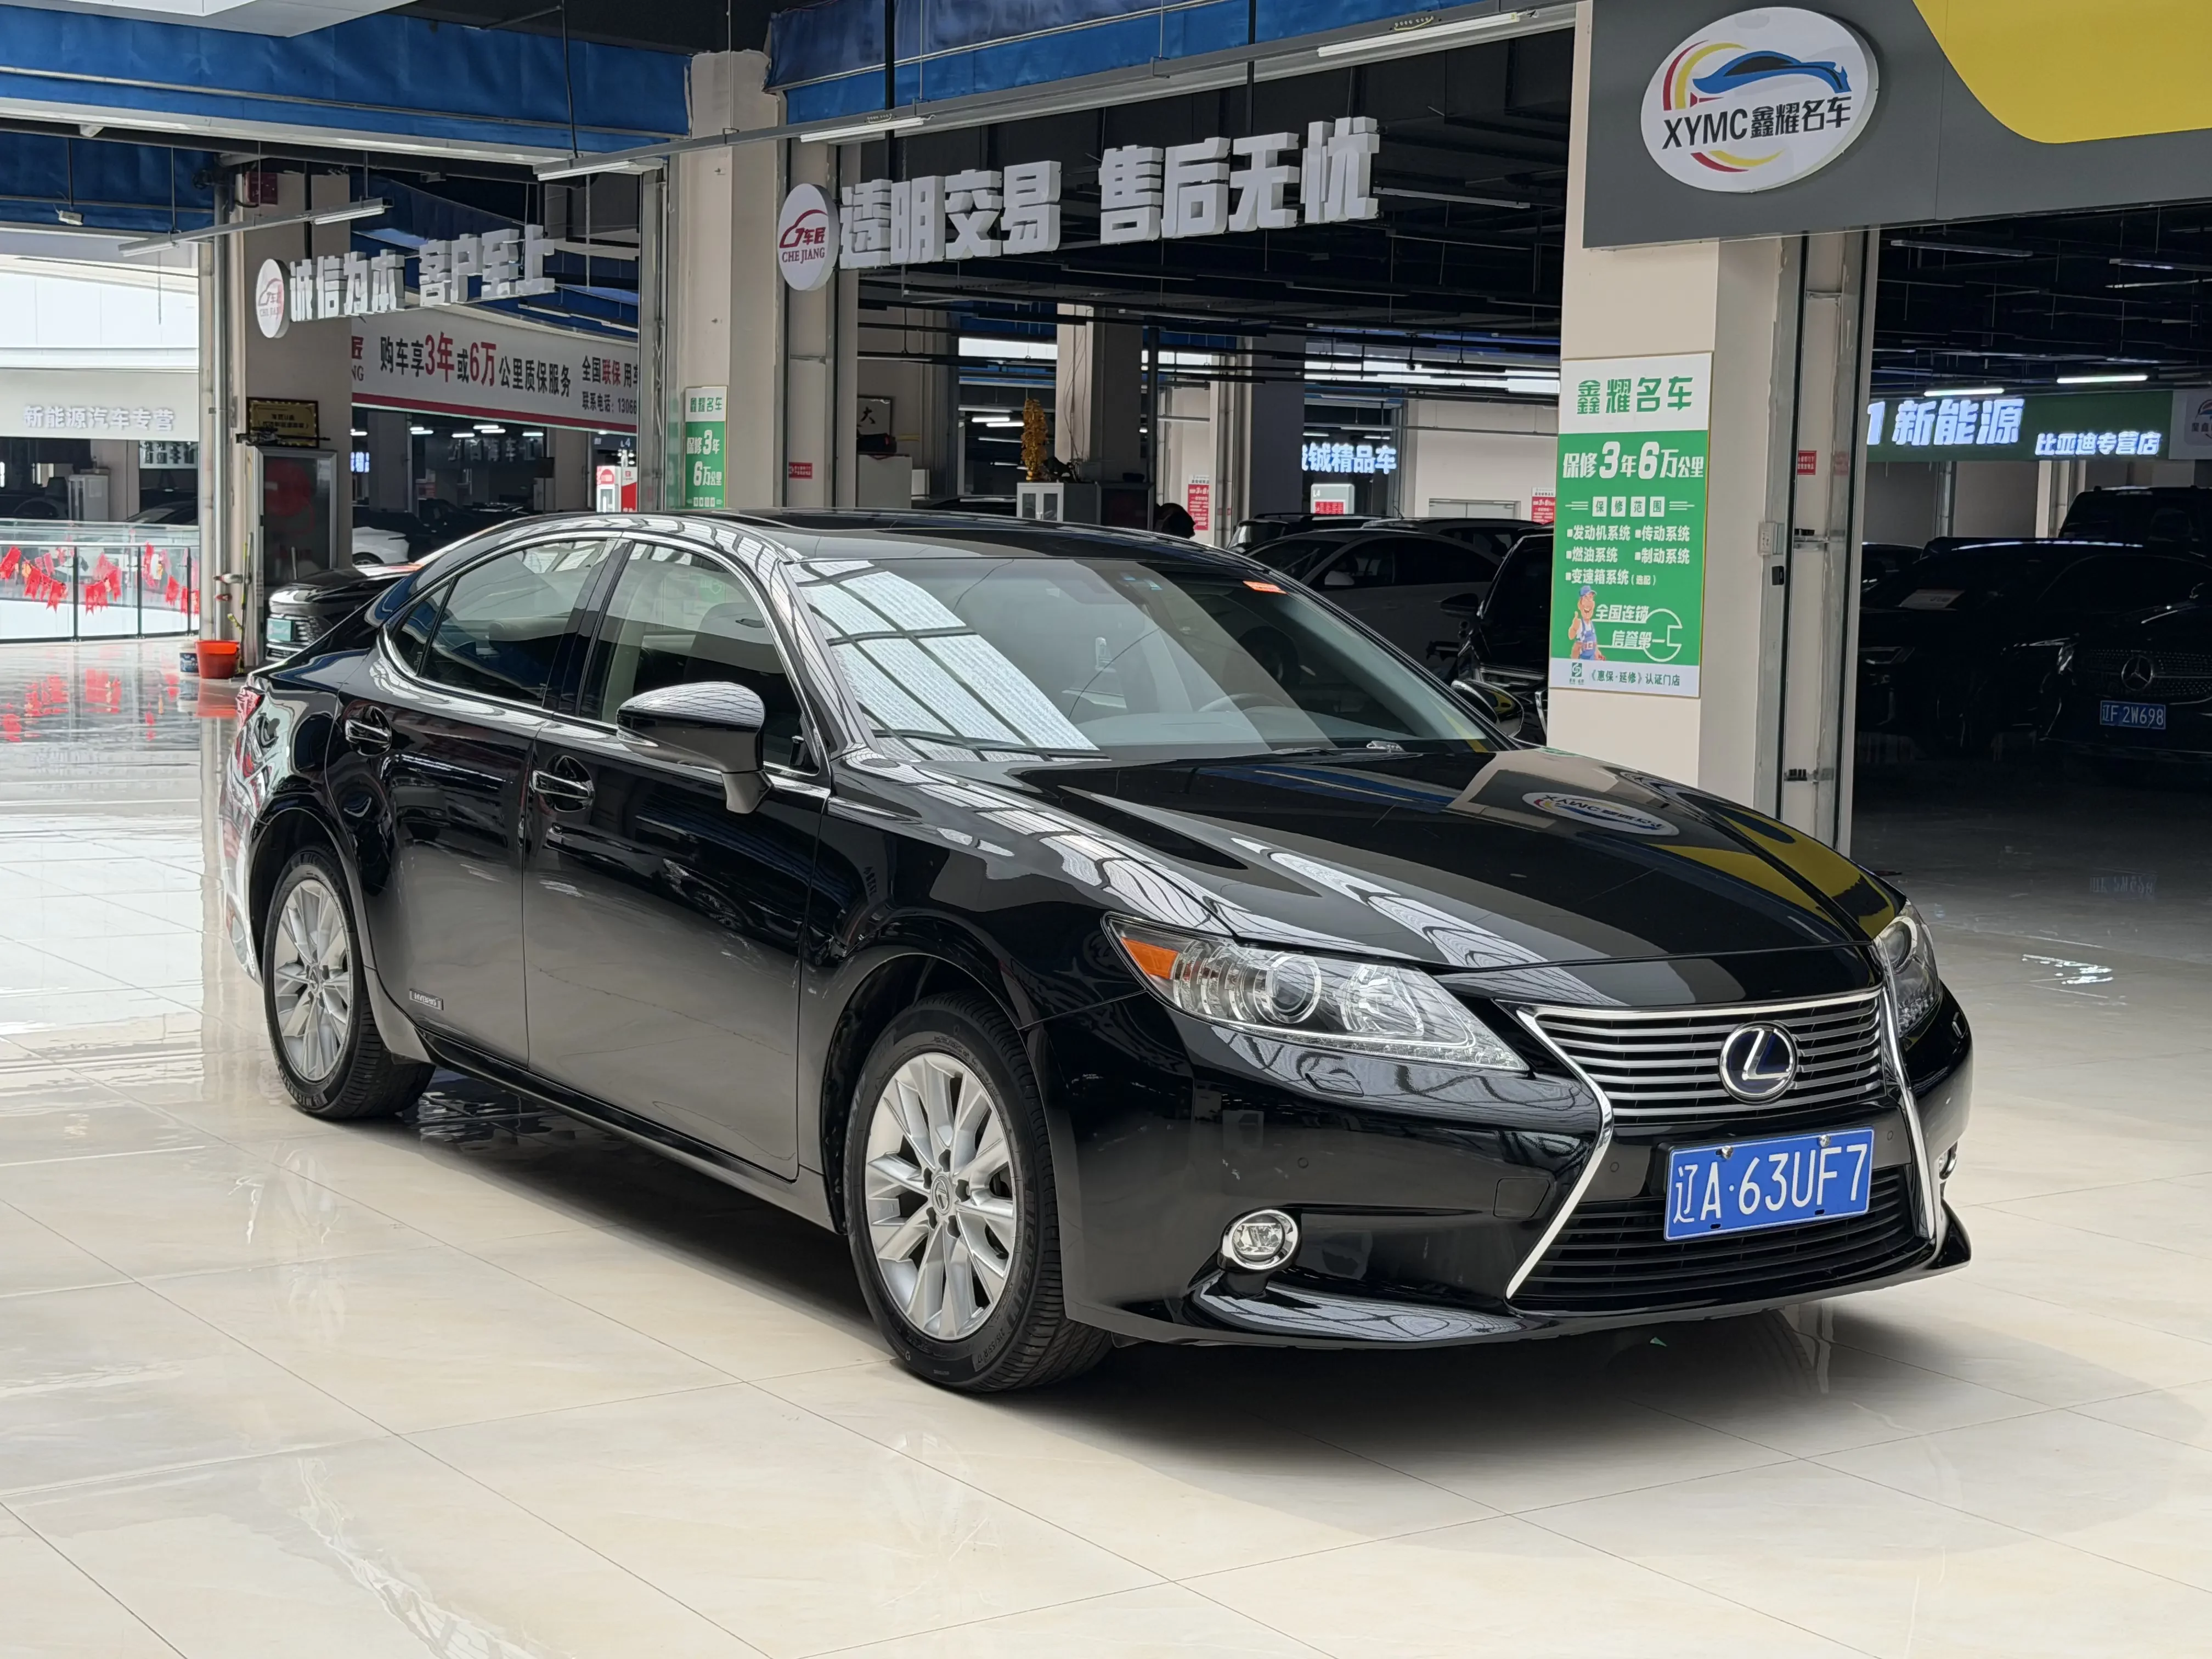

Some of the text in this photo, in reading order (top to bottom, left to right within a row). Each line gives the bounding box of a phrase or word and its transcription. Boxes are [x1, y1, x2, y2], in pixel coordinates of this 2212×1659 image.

[839, 116, 1380, 269] 透明交易 售后无忧
[782, 247, 825, 264] CHE JIANG
[290, 224, 555, 322] 诚信为本 客户至上
[380, 331, 571, 397] 购车享3年或6万公里质保服务
[582, 356, 621, 386] 全国联保
[1577, 376, 1693, 415] 鑫耀名车
[24, 405, 174, 432] 新能源汽车专营
[1892, 399, 2025, 445] 新能源
[687, 429, 720, 455] 保修3年
[2035, 431, 2162, 455] 比亚迪专营店
[693, 461, 722, 486] 6万公里
[1562, 441, 1704, 479] 保修3年6万公里
[1595, 500, 1662, 514] 保修范围
[1573, 524, 1690, 541] 发动机系统 传动系统
[1572, 546, 1690, 564] 燃油系统 制动系统
[1595, 604, 1649, 623] 全国连锁
[1673, 1143, 1868, 1224] 辽A·63UF7
